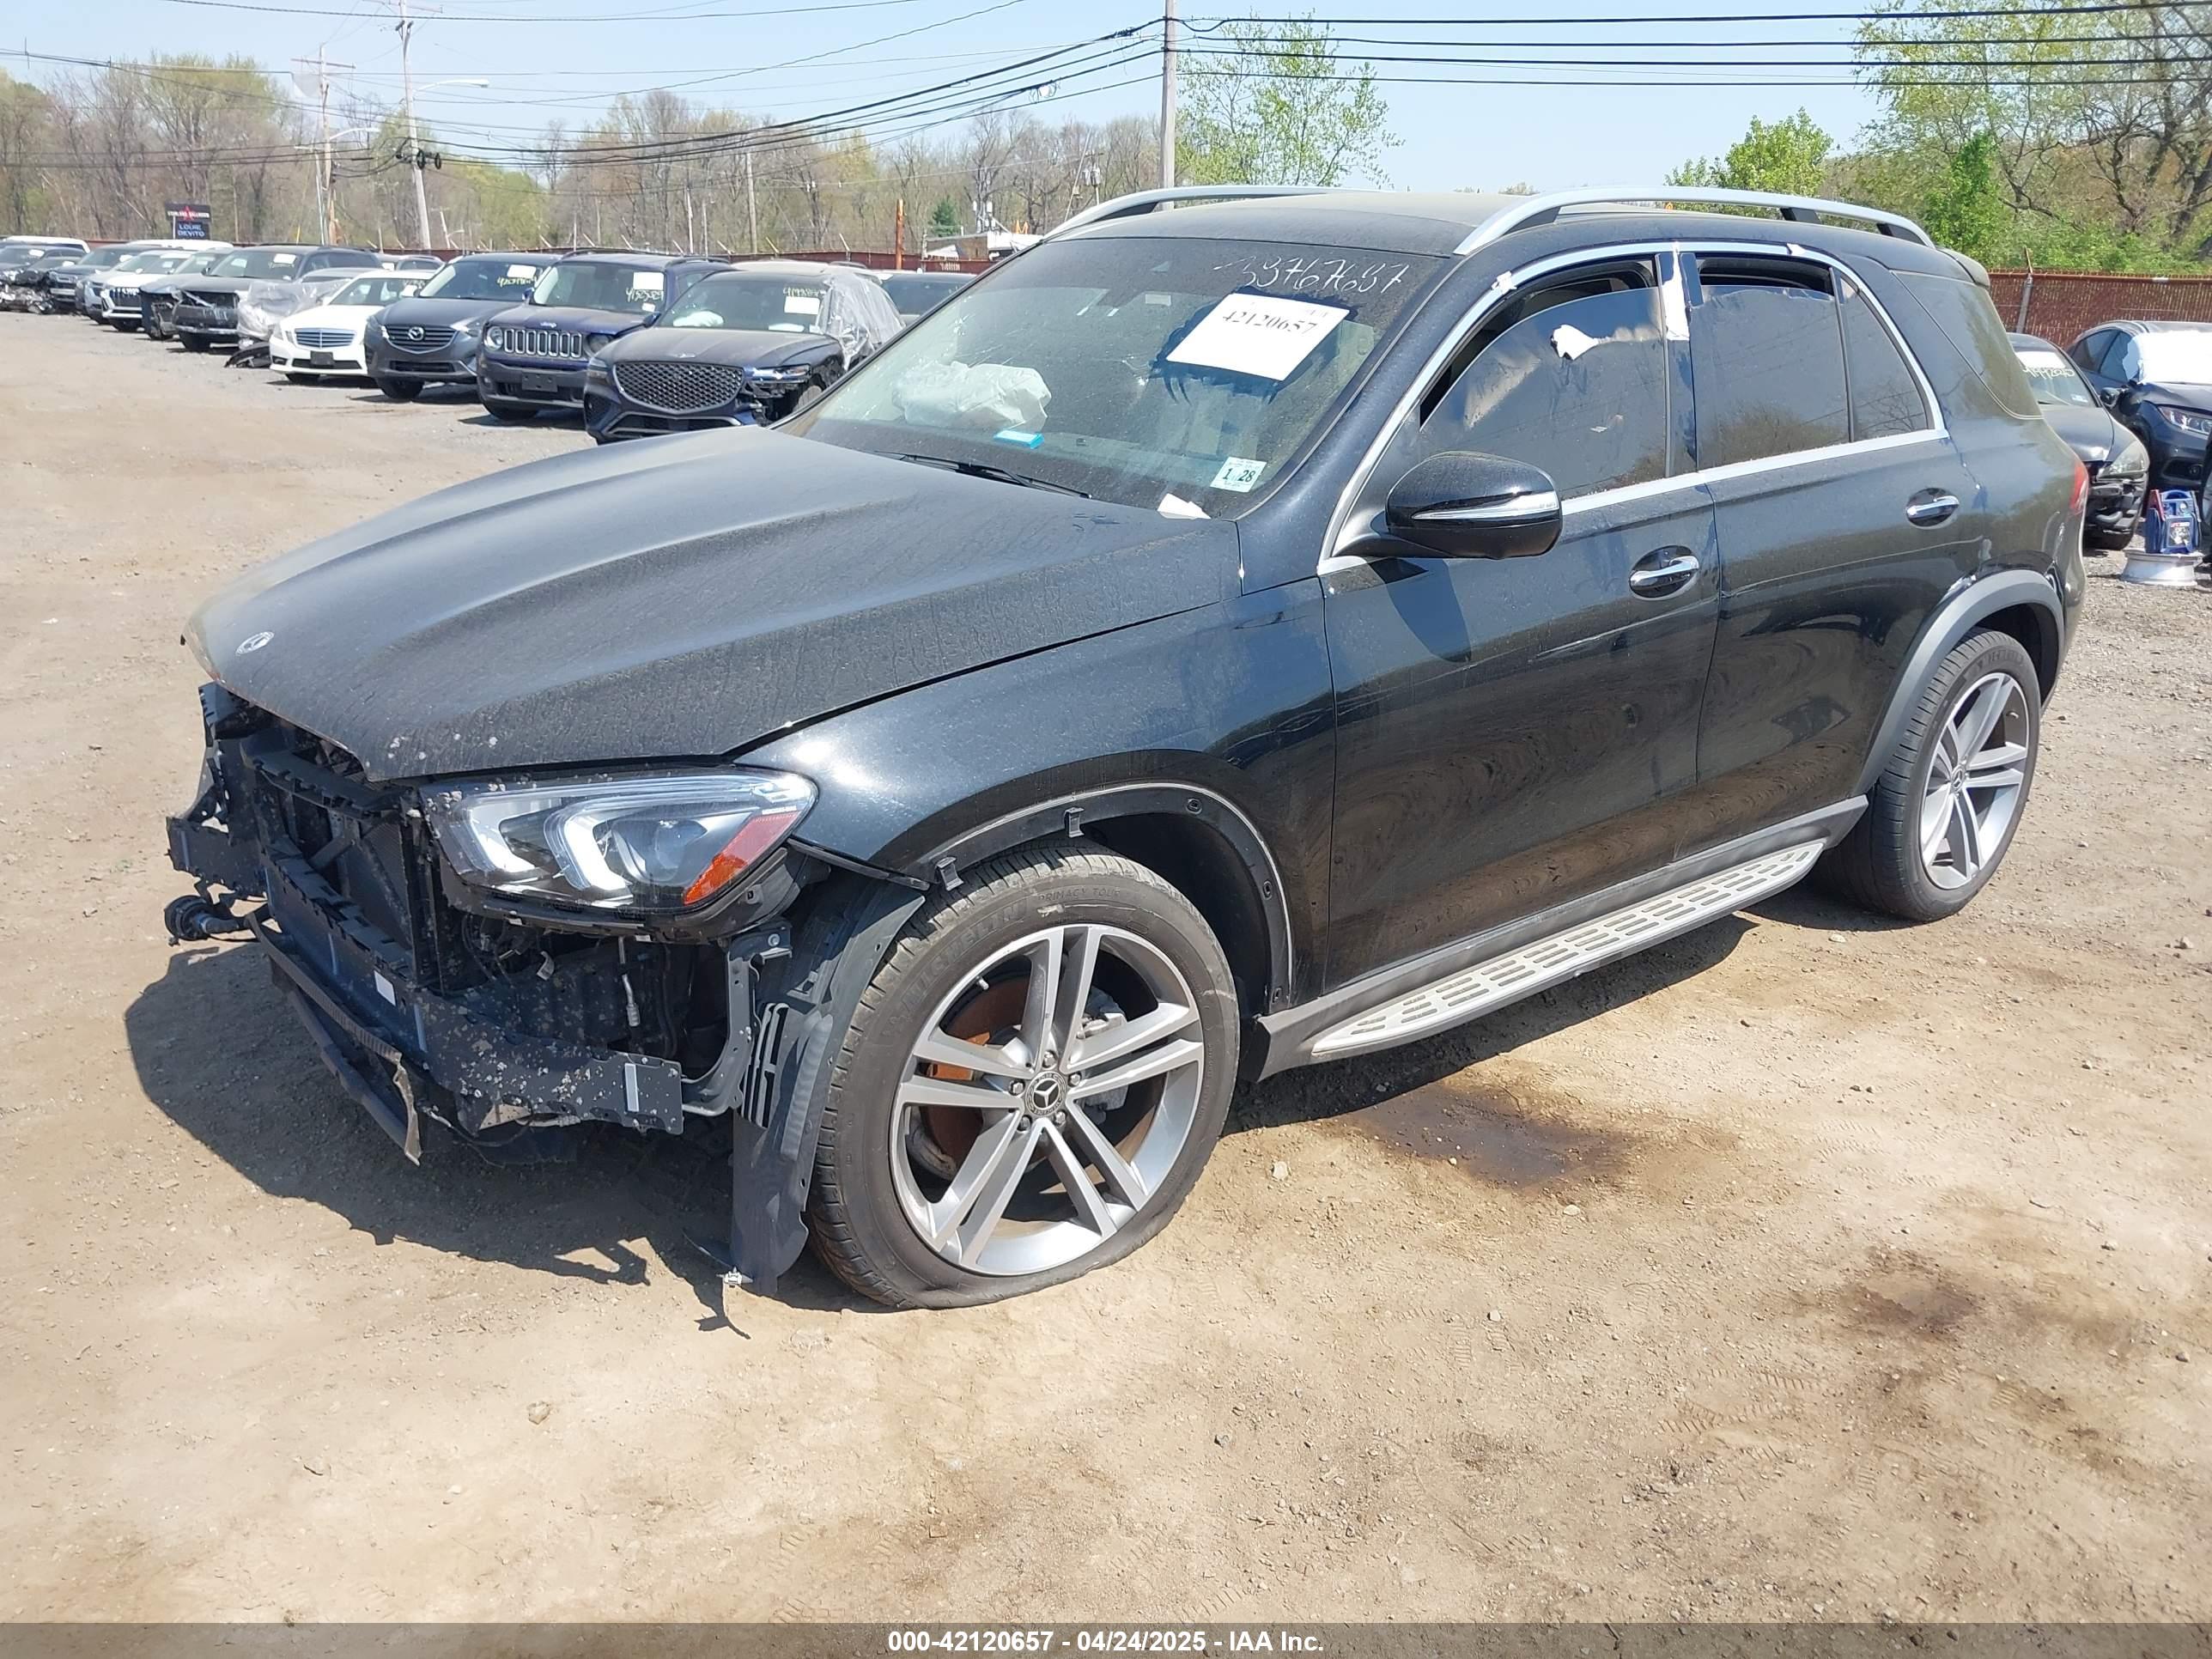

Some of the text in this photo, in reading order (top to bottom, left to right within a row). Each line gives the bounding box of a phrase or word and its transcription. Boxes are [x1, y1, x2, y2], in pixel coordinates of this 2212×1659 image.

[1223, 310, 1318, 335] 42120657
[1222, 467, 1256, 483] 1 28
